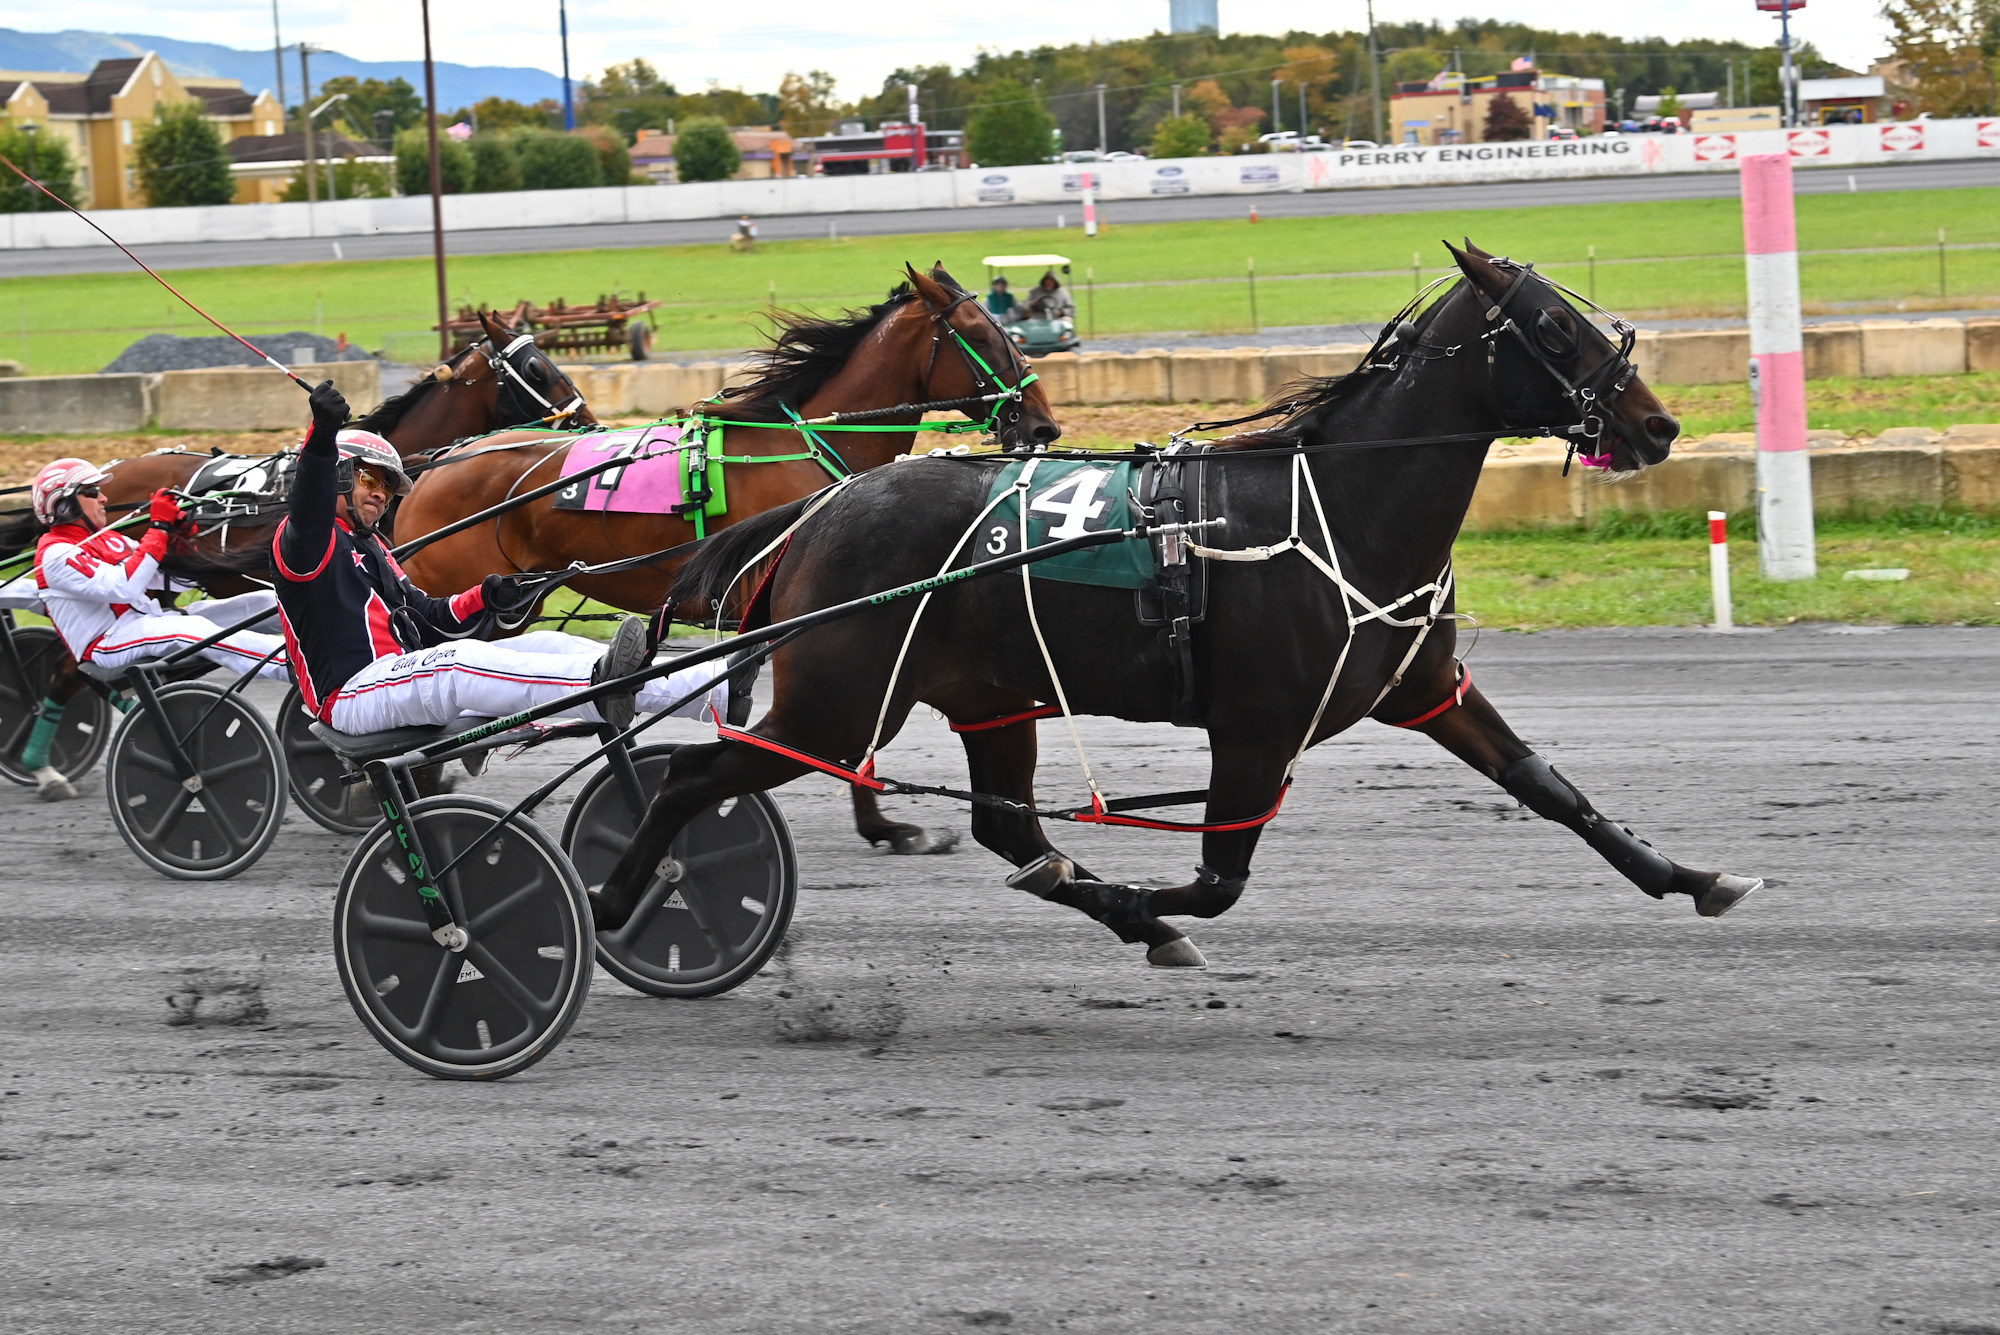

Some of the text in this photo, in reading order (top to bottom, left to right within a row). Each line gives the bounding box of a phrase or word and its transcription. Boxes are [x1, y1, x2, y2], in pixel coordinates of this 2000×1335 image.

[1340, 151, 1427, 166] PERRY
[1438, 141, 1630, 162] ENGINEERING
[593, 435, 653, 488] 7
[562, 482, 578, 499] 3
[1029, 468, 1108, 541] 4
[986, 526, 1009, 555] 3
[391, 655, 419, 671] Billy
[457, 709, 533, 744] FERN PAQUET
[667, 899, 684, 907] FMT
[460, 970, 477, 980] FMT
